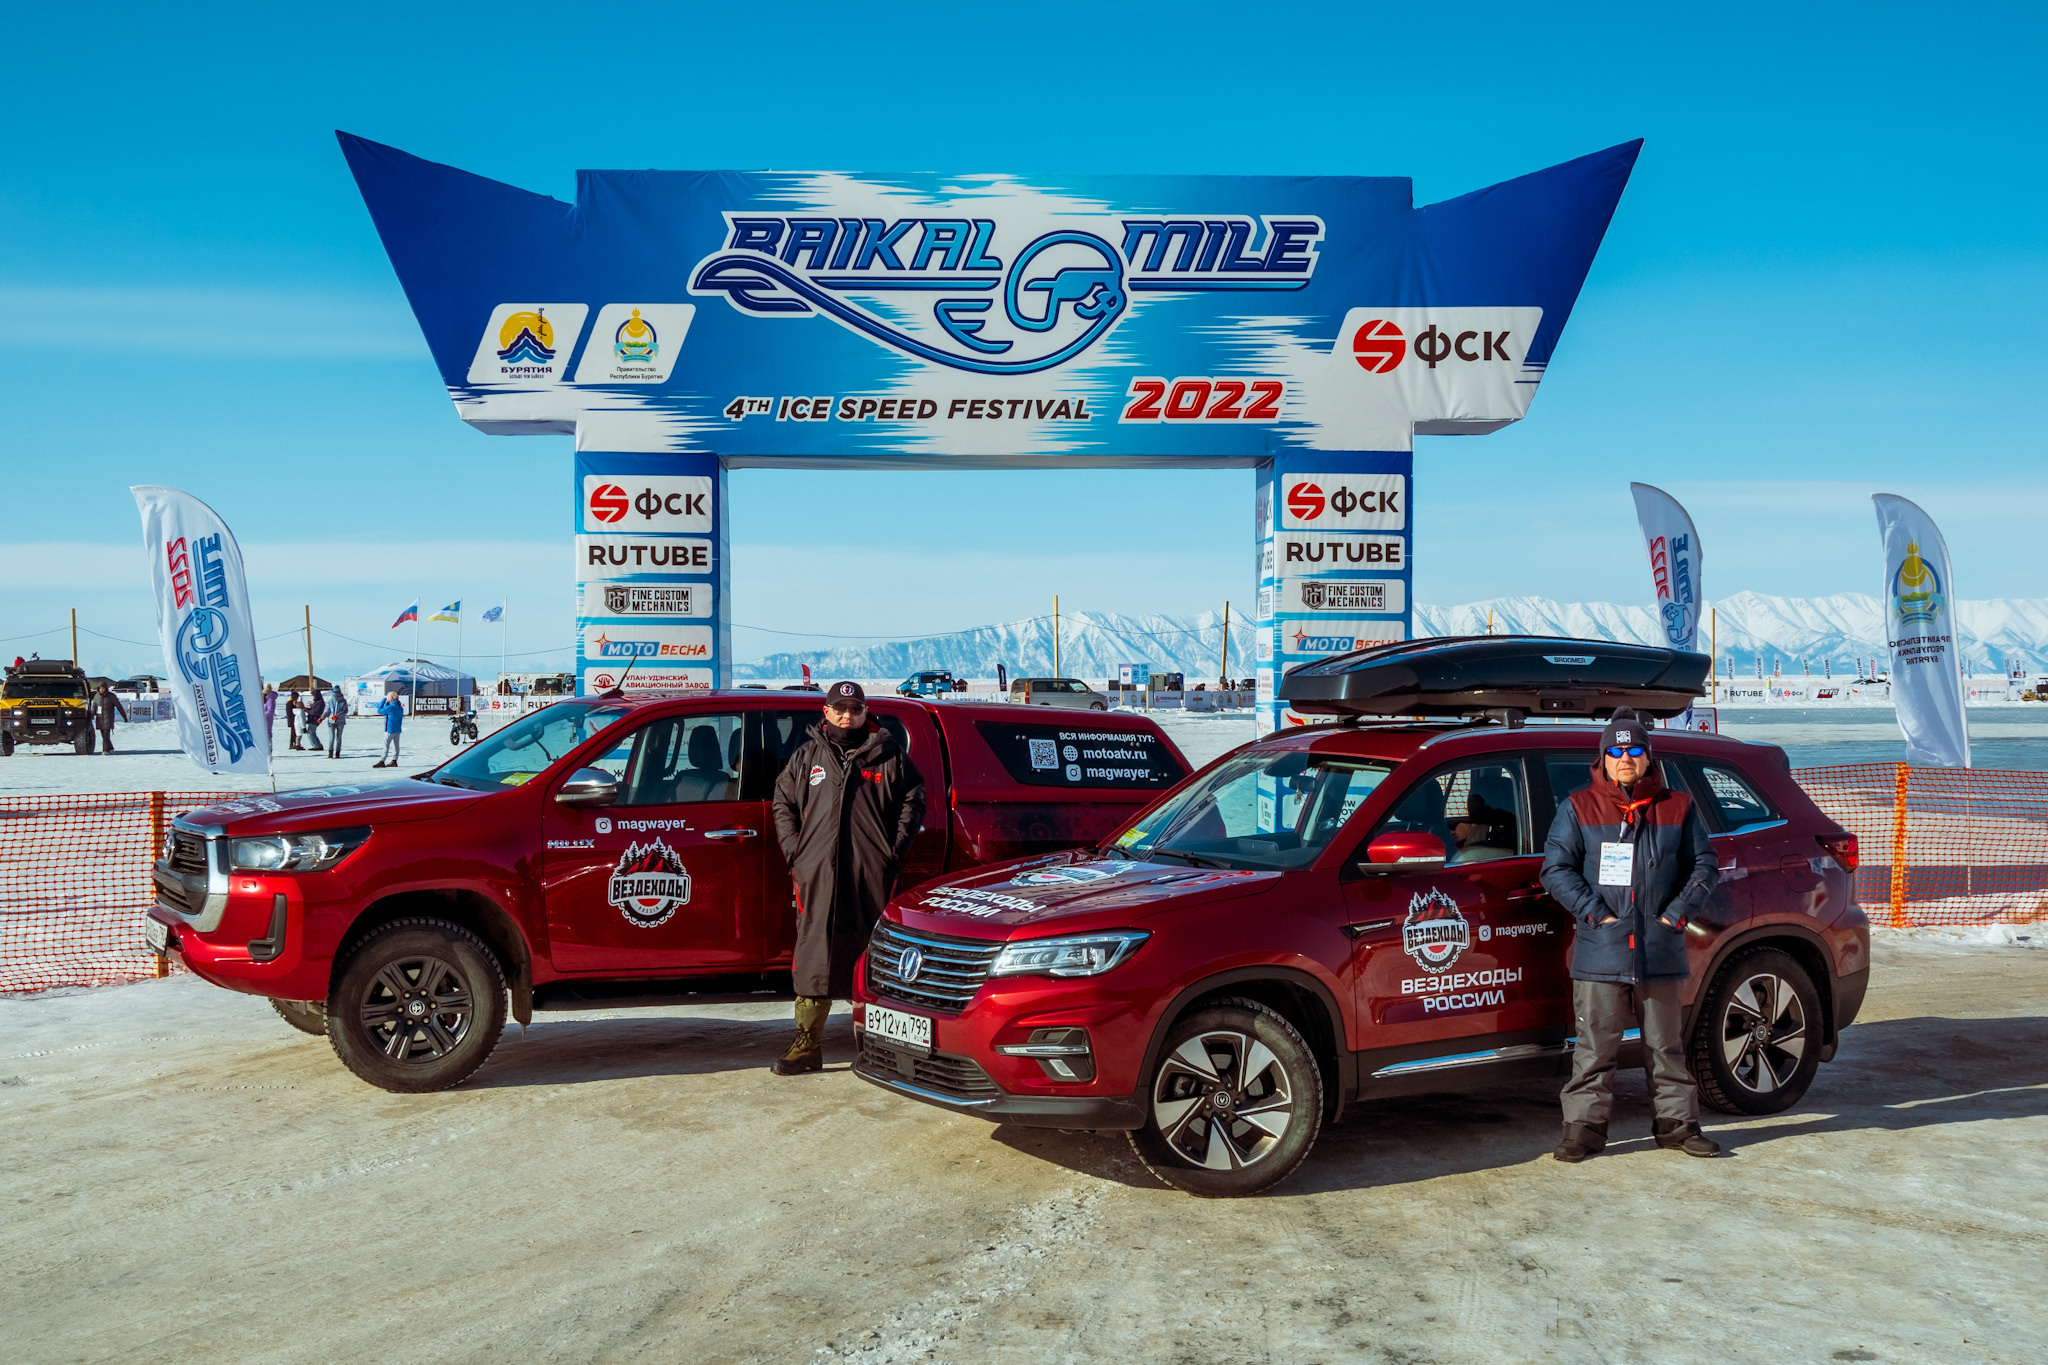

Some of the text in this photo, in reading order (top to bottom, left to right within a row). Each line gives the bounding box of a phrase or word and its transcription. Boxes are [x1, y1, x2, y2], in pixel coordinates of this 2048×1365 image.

[731, 217, 1321, 273] BAIKAL MILE
[1413, 324, 1511, 369] ФСК
[501, 366, 552, 374] БУРЯТИЯ
[725, 398, 1091, 421] 4TH ICE SPEED FESTIVAL
[1123, 380, 1284, 421] 2022
[634, 487, 706, 520] ФСК
[1330, 486, 1399, 518] ФСК
[588, 545, 708, 566] RUTUBE
[1286, 542, 1401, 563] RUTUBE
[632, 589, 689, 601] FINE CUSTOM
[1328, 585, 1383, 597] FINE CUSTOM
[632, 601, 689, 612] MECHANICS
[1328, 597, 1383, 608] MECHANICS
[1553, 656, 1586, 664] BROOMER
[1059, 732, 1156, 743] ВСЯ ИНФОРМАЦИЯ ТУТ:
[1083, 748, 1147, 760] motoatv.ru
[1086, 767, 1159, 781] magwayer_
[617, 819, 695, 832] magwayer_
[613, 879, 687, 900] ВЕЗДЕХОДЫ
[927, 886, 1046, 913] ВЕЗДЕХОДЫ
[918, 896, 1001, 918] РОССИИ
[1406, 924, 1467, 950] ВЕЗДЕХОДЫ
[1495, 922, 1554, 938] magwayer_
[1401, 967, 1523, 995] ВЕЗДЕХОДЫ
[1423, 989, 1506, 1013] РОССИИ
[910, 1016, 928, 1036] 799
